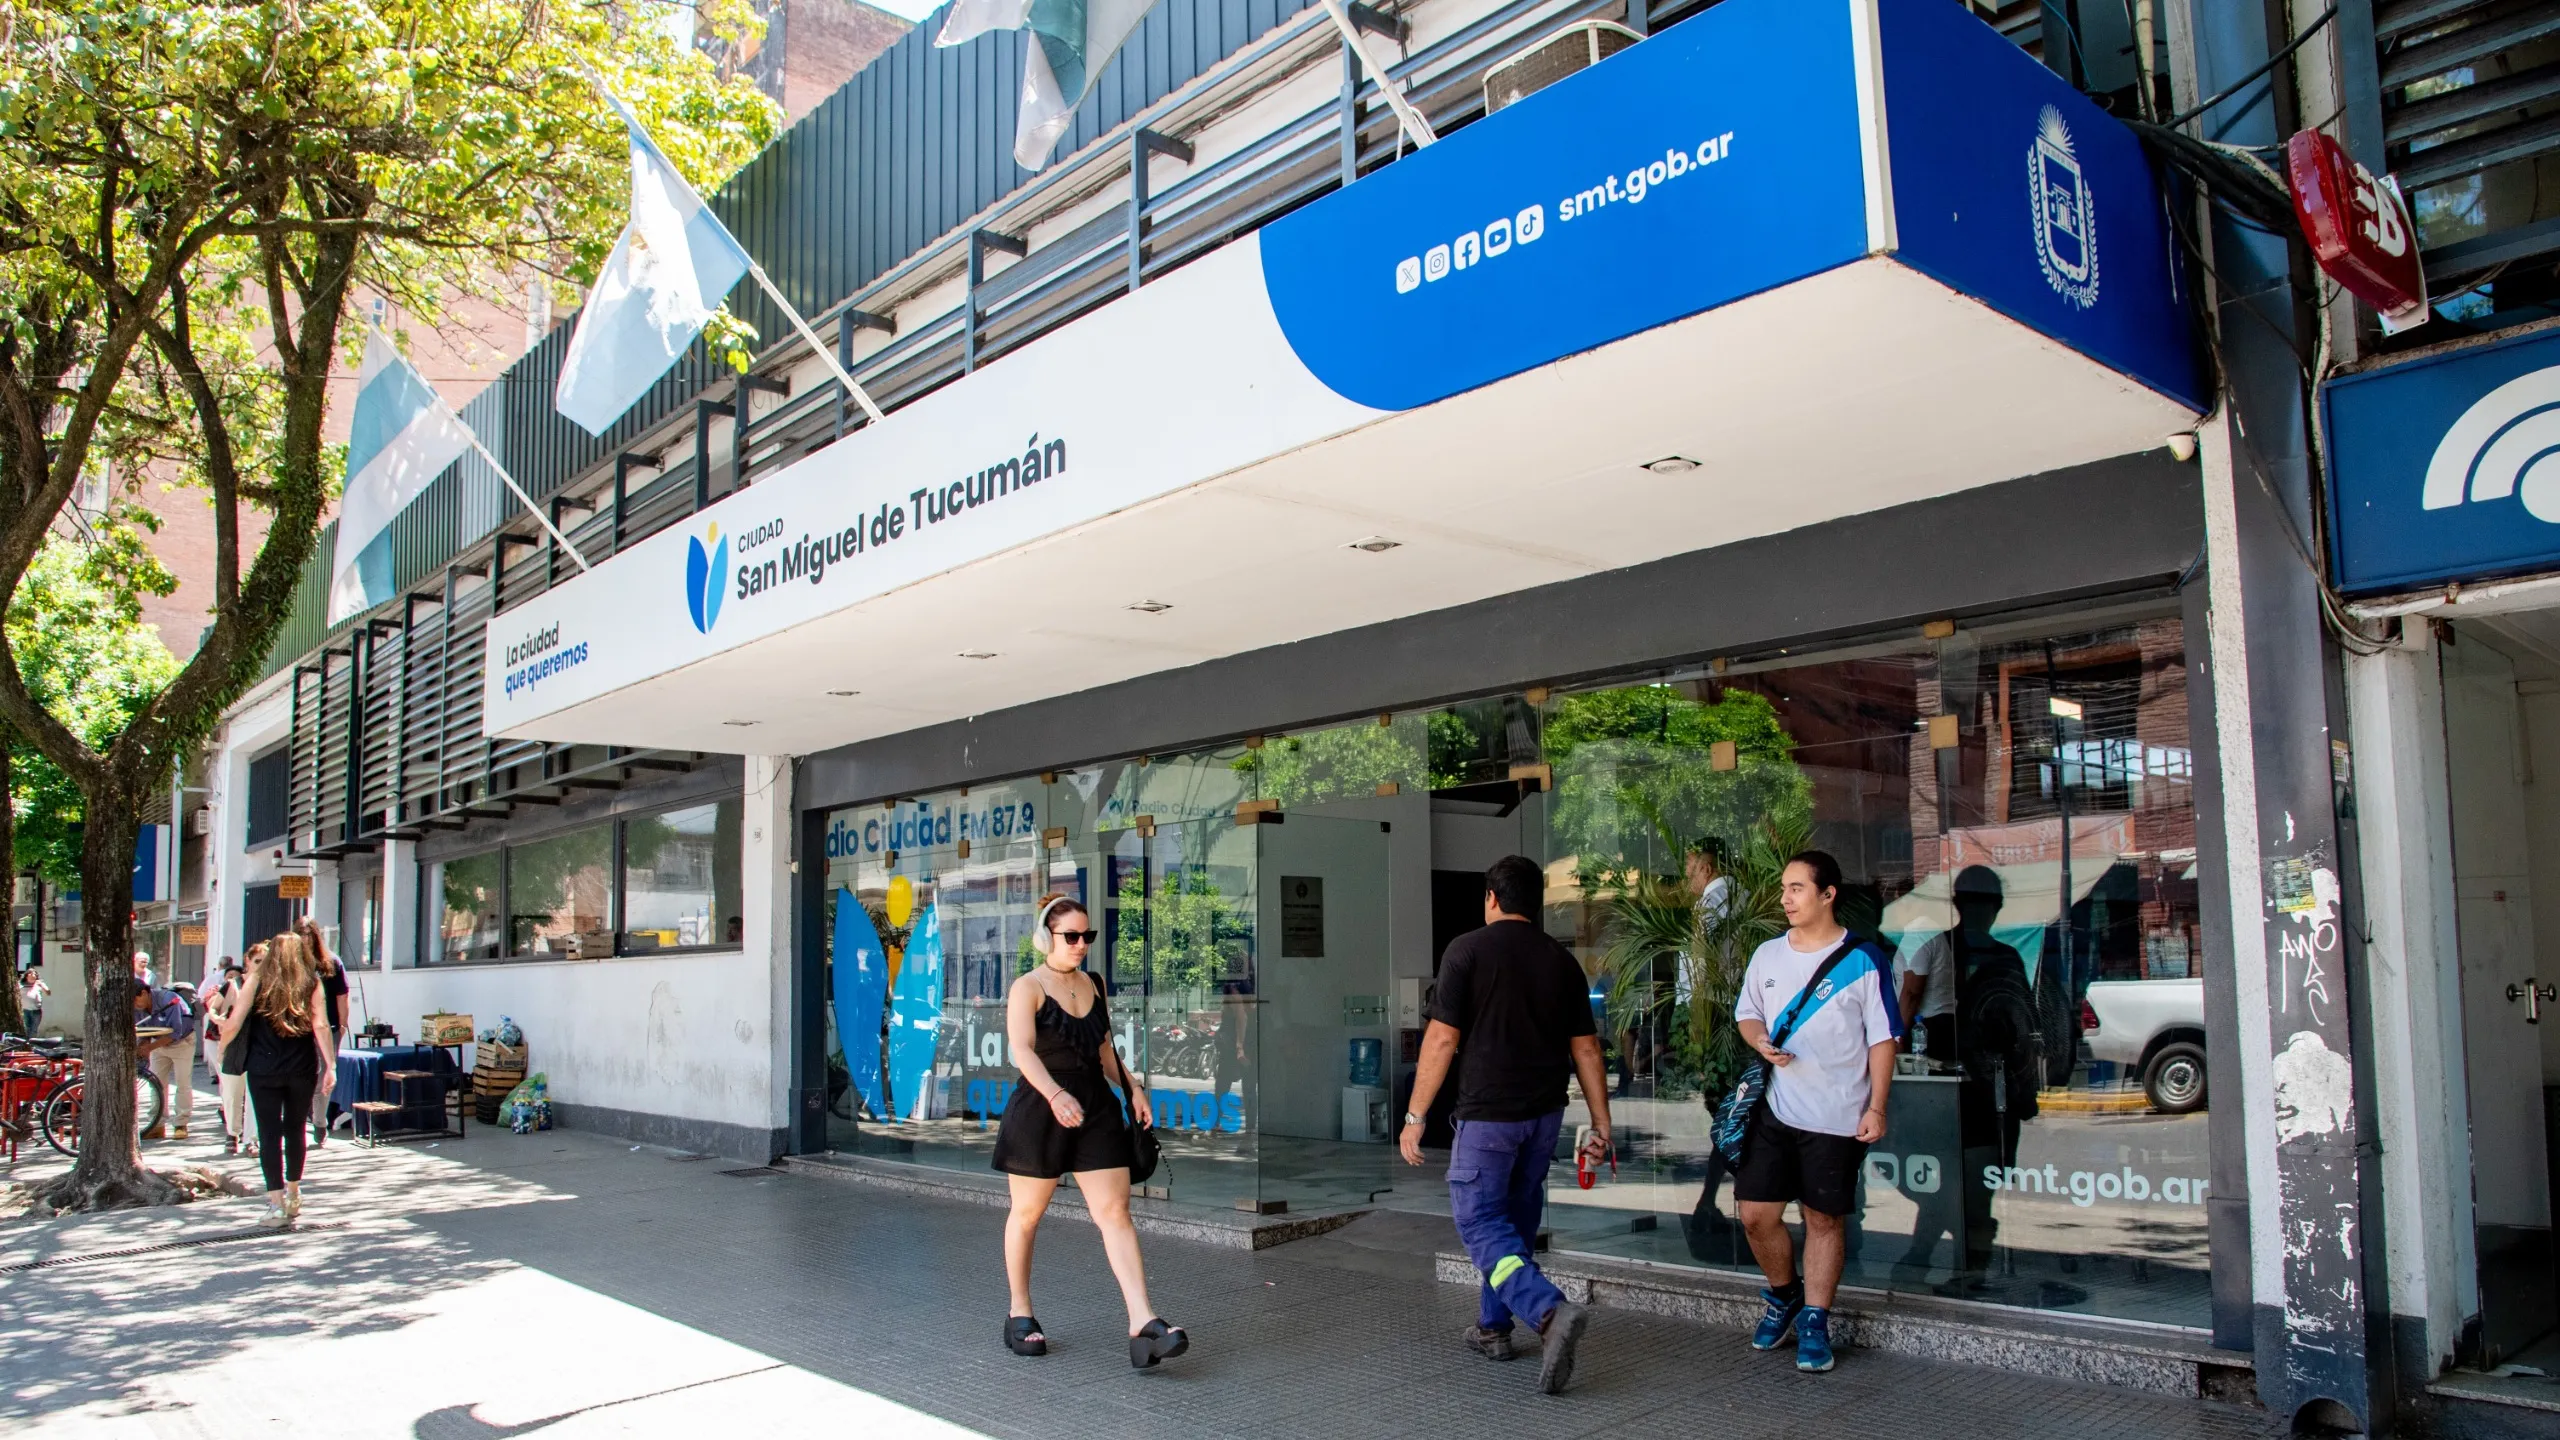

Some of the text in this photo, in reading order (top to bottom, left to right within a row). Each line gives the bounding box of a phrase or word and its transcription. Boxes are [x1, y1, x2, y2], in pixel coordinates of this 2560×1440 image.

[1559, 130, 1734, 222] smt.gob.ar
[737, 431, 1066, 600] San Miguel de Tucumán
[738, 518, 784, 553] CIUDAD
[506, 620, 559, 668] La ciudad
[505, 641, 588, 701] que queremos
[864, 805, 951, 853] Ciudad
[959, 810, 988, 840] FM
[992, 802, 1034, 837] 87.9
[967, 1023, 1001, 1067] La
[967, 1079, 1017, 1131] qu
[1983, 1163, 2209, 1208] smt.gob.ar
